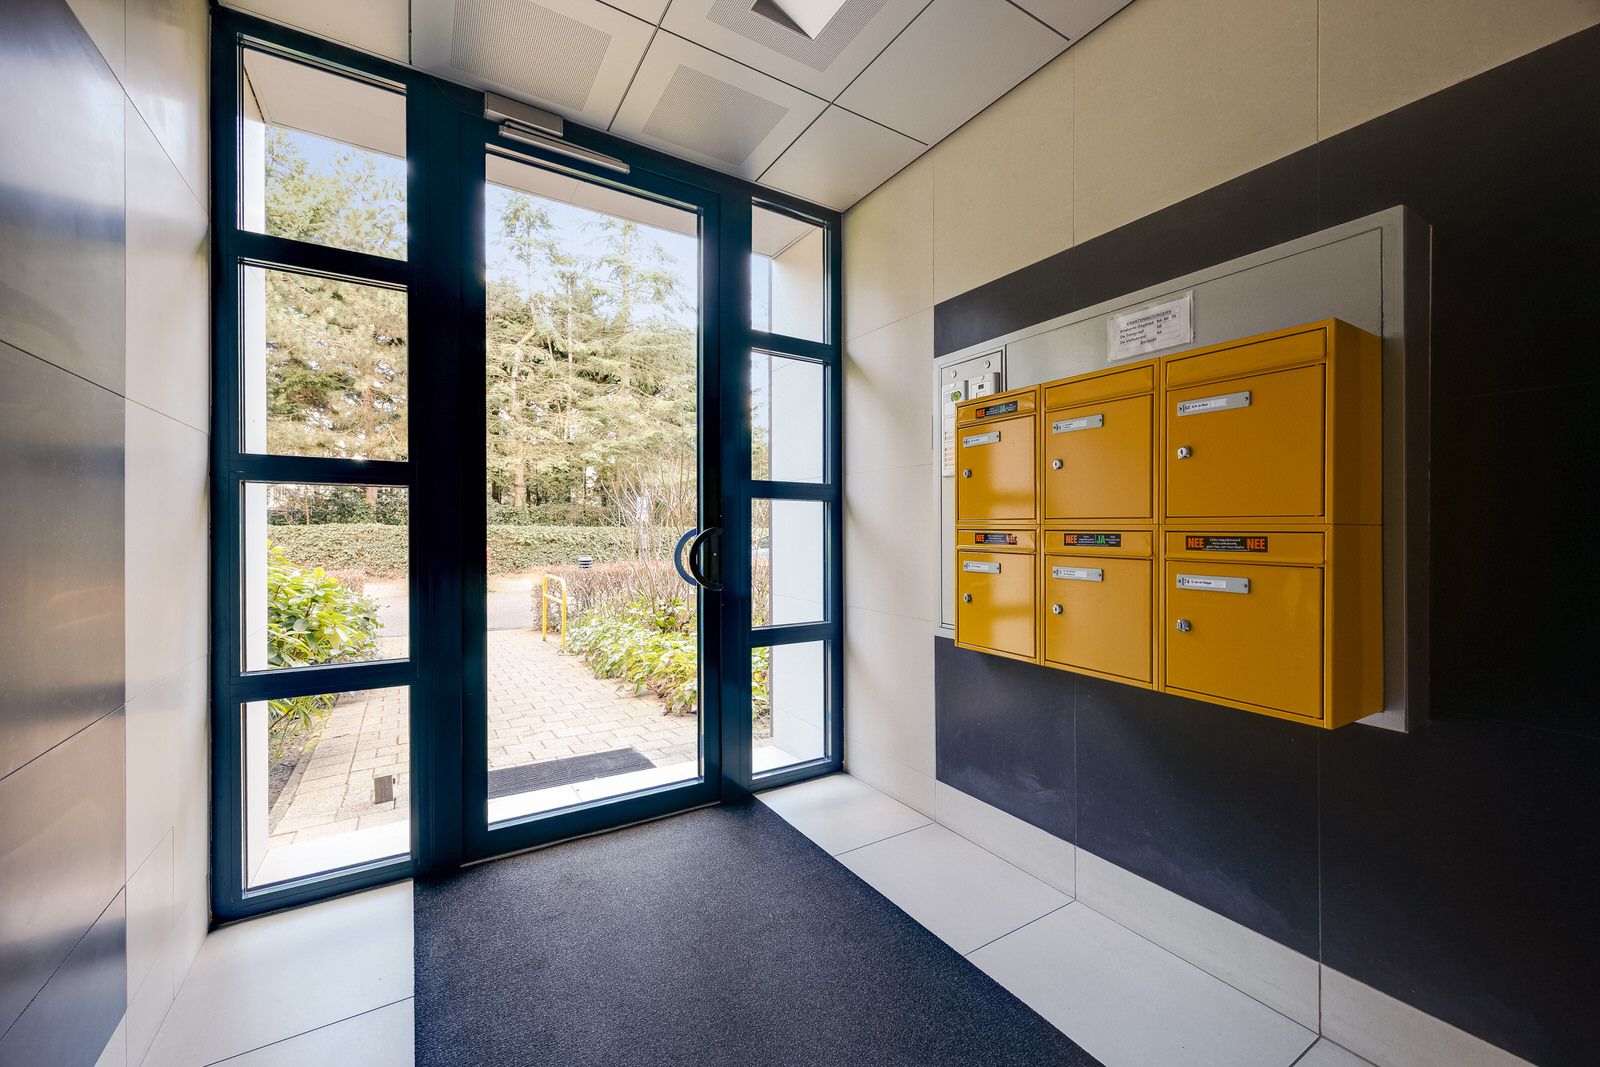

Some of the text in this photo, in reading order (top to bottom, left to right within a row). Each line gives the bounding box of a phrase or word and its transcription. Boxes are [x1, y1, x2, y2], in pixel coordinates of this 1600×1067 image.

[976, 409, 986, 418] NEE
[975, 534, 985, 543] NEE
[1065, 535, 1078, 544] NEE
[1096, 535, 1106, 545] JA
[1187, 537, 1205, 548] NEE
[1247, 538, 1266, 549] NEE
